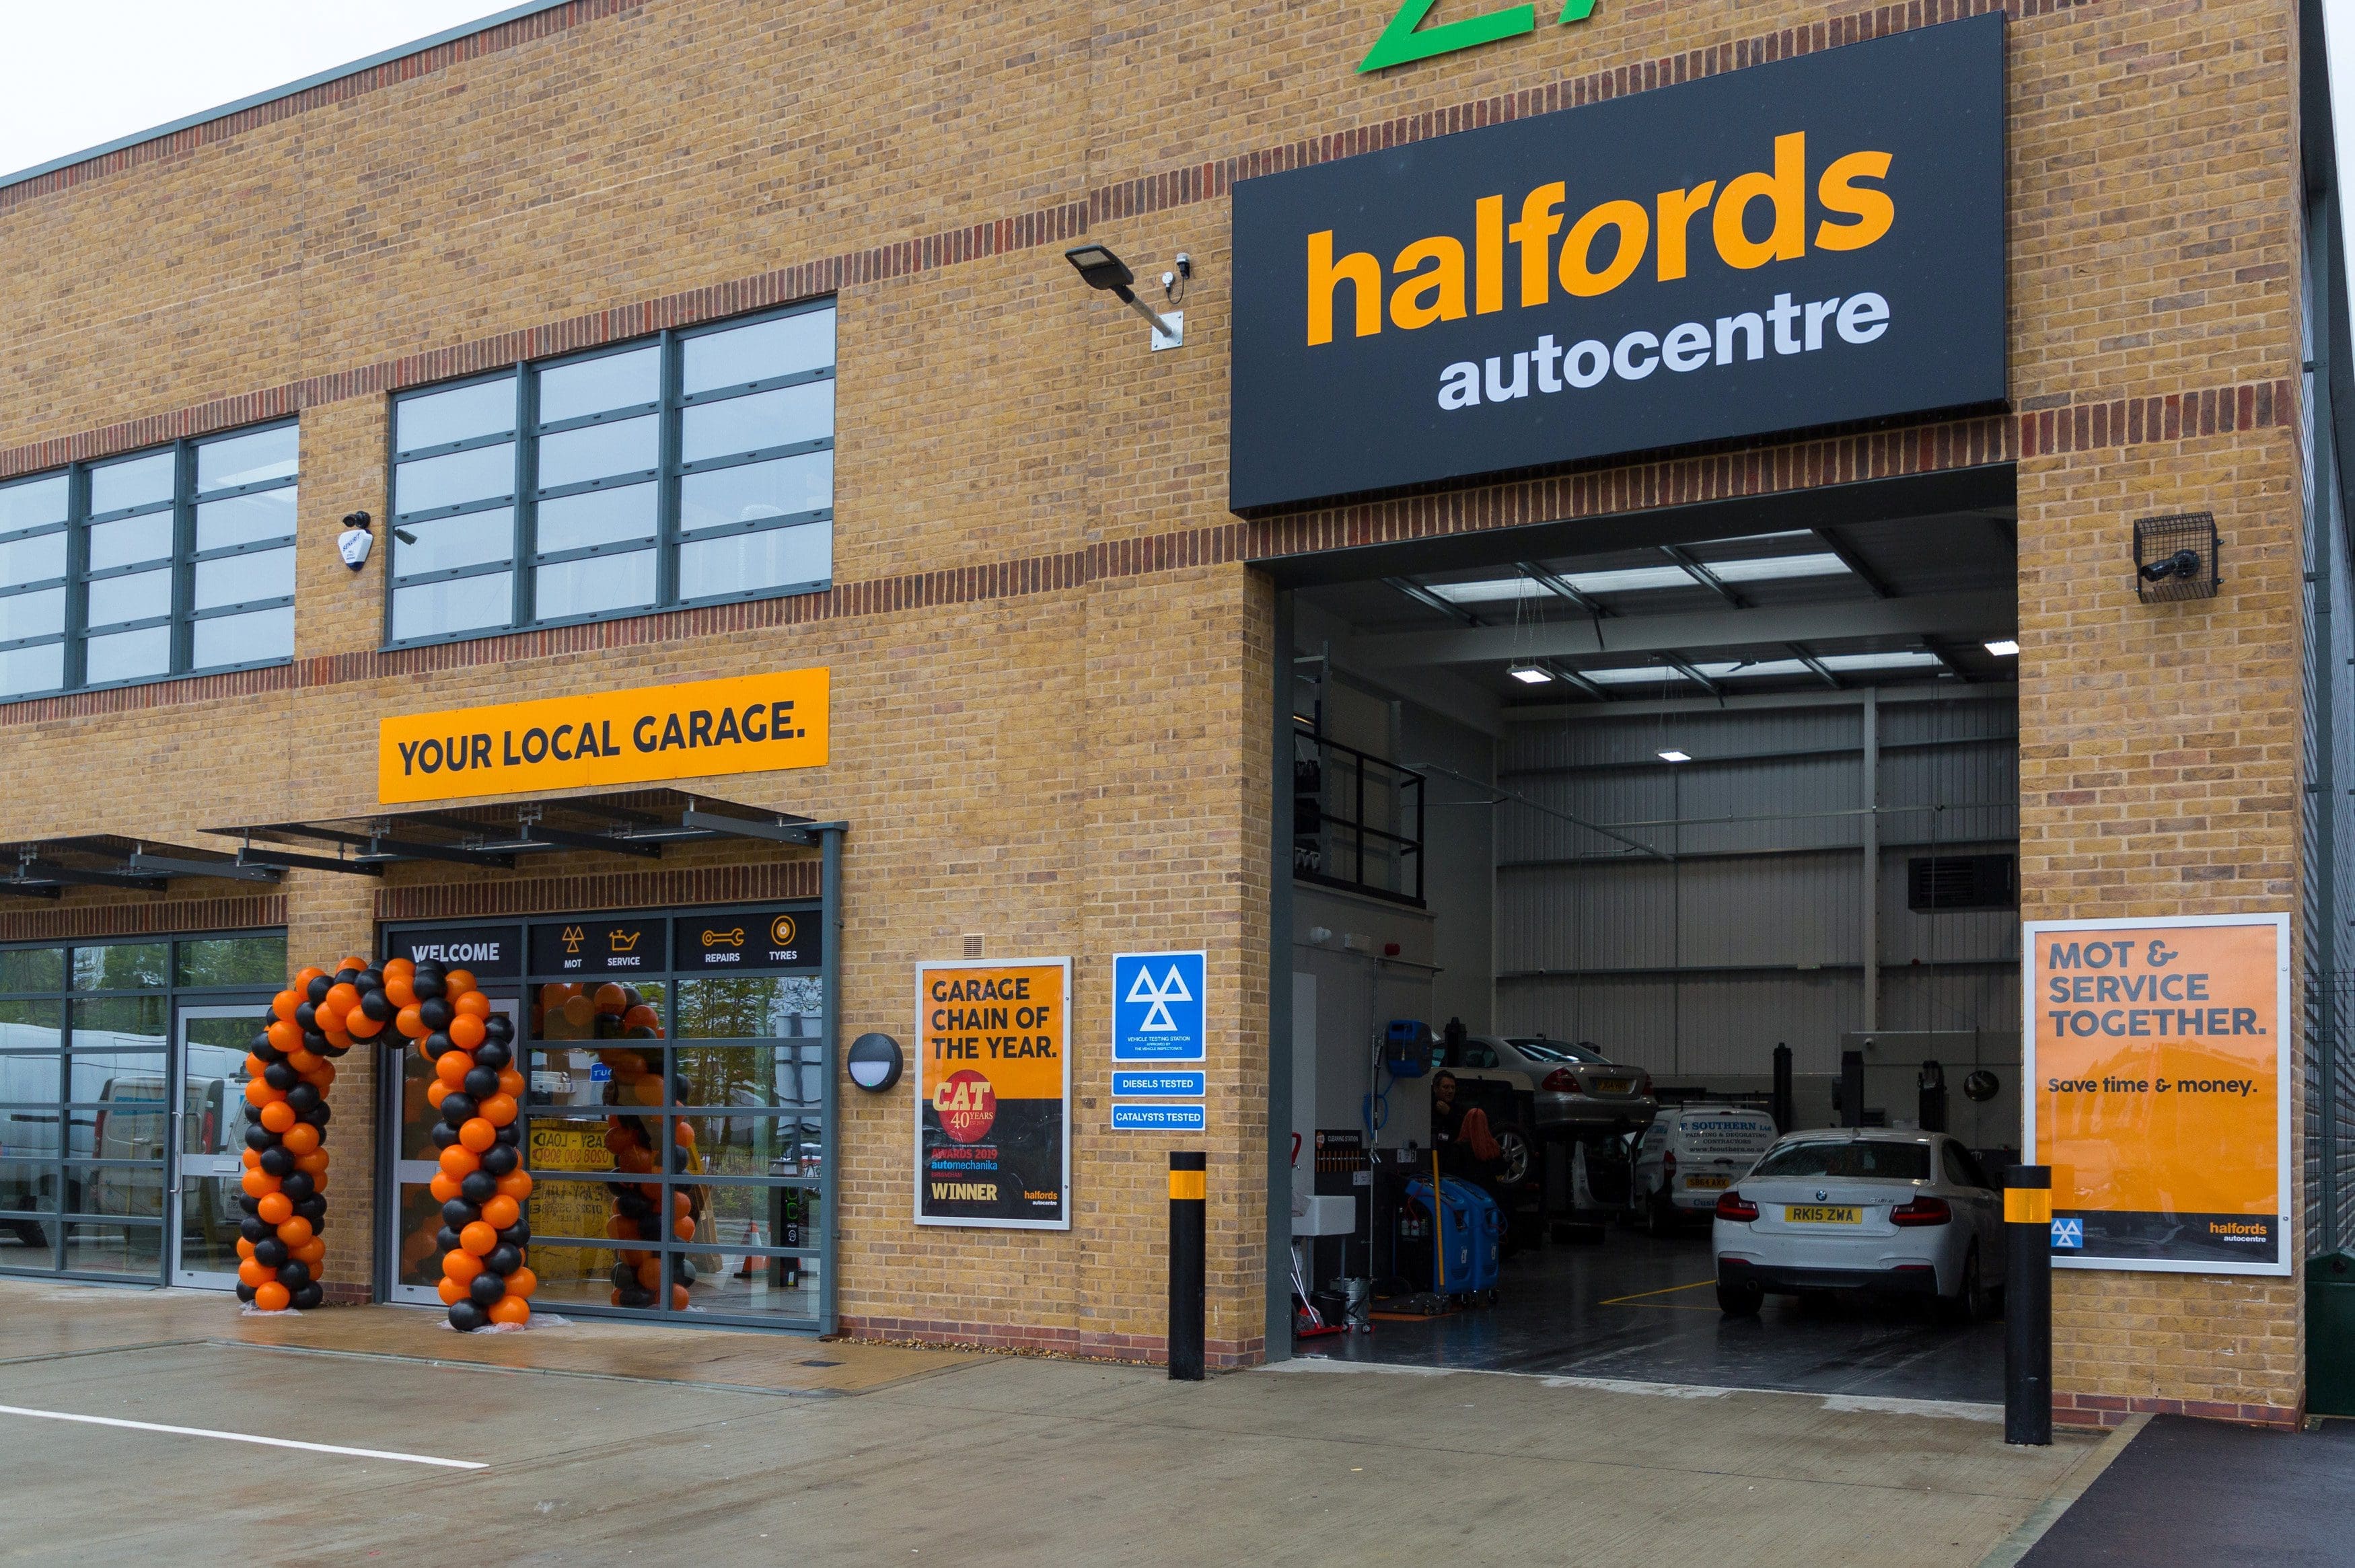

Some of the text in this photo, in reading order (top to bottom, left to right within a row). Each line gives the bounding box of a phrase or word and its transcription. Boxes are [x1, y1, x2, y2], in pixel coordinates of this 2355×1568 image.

[1307, 130, 1895, 346] halfords
[1437, 292, 1890, 410] autocentre
[398, 700, 805, 776] YOUR LOCAL GARAGE.
[412, 942, 500, 963] WELCOME
[607, 956, 641, 966] SERVICE
[705, 953, 740, 963] REPAIRS
[769, 950, 797, 961] TYRES
[2049, 940, 2179, 969] MOT &
[564, 959, 582, 969] MOT
[931, 977, 1030, 1003] GARAGE
[2048, 973, 2210, 1003] SERVICE
[931, 1006, 1050, 1031] CHAIN OF
[2048, 1007, 2266, 1037] TOGETHER.
[931, 1035, 1057, 1059] THE YEAR.
[1122, 1080, 1194, 1088] DIESELS TESTED
[2048, 1076, 2257, 1097] Save time & money.
[933, 1082, 991, 1111] CAT
[951, 1111, 970, 1129] 40
[970, 1112, 993, 1120] YEARS
[1116, 1113, 1201, 1121] CATALYSTS TESTED
[1692, 1122, 1756, 1131] SOUTHERN
[931, 1148, 998, 1159] AWARDS 2019
[931, 1160, 998, 1170] automechanika
[931, 1183, 998, 1202] WINNER
[1024, 1190, 1058, 1199] halfords
[1792, 1208, 1854, 1222] RK15 ZWA
[2210, 1222, 2268, 1235] halfords
